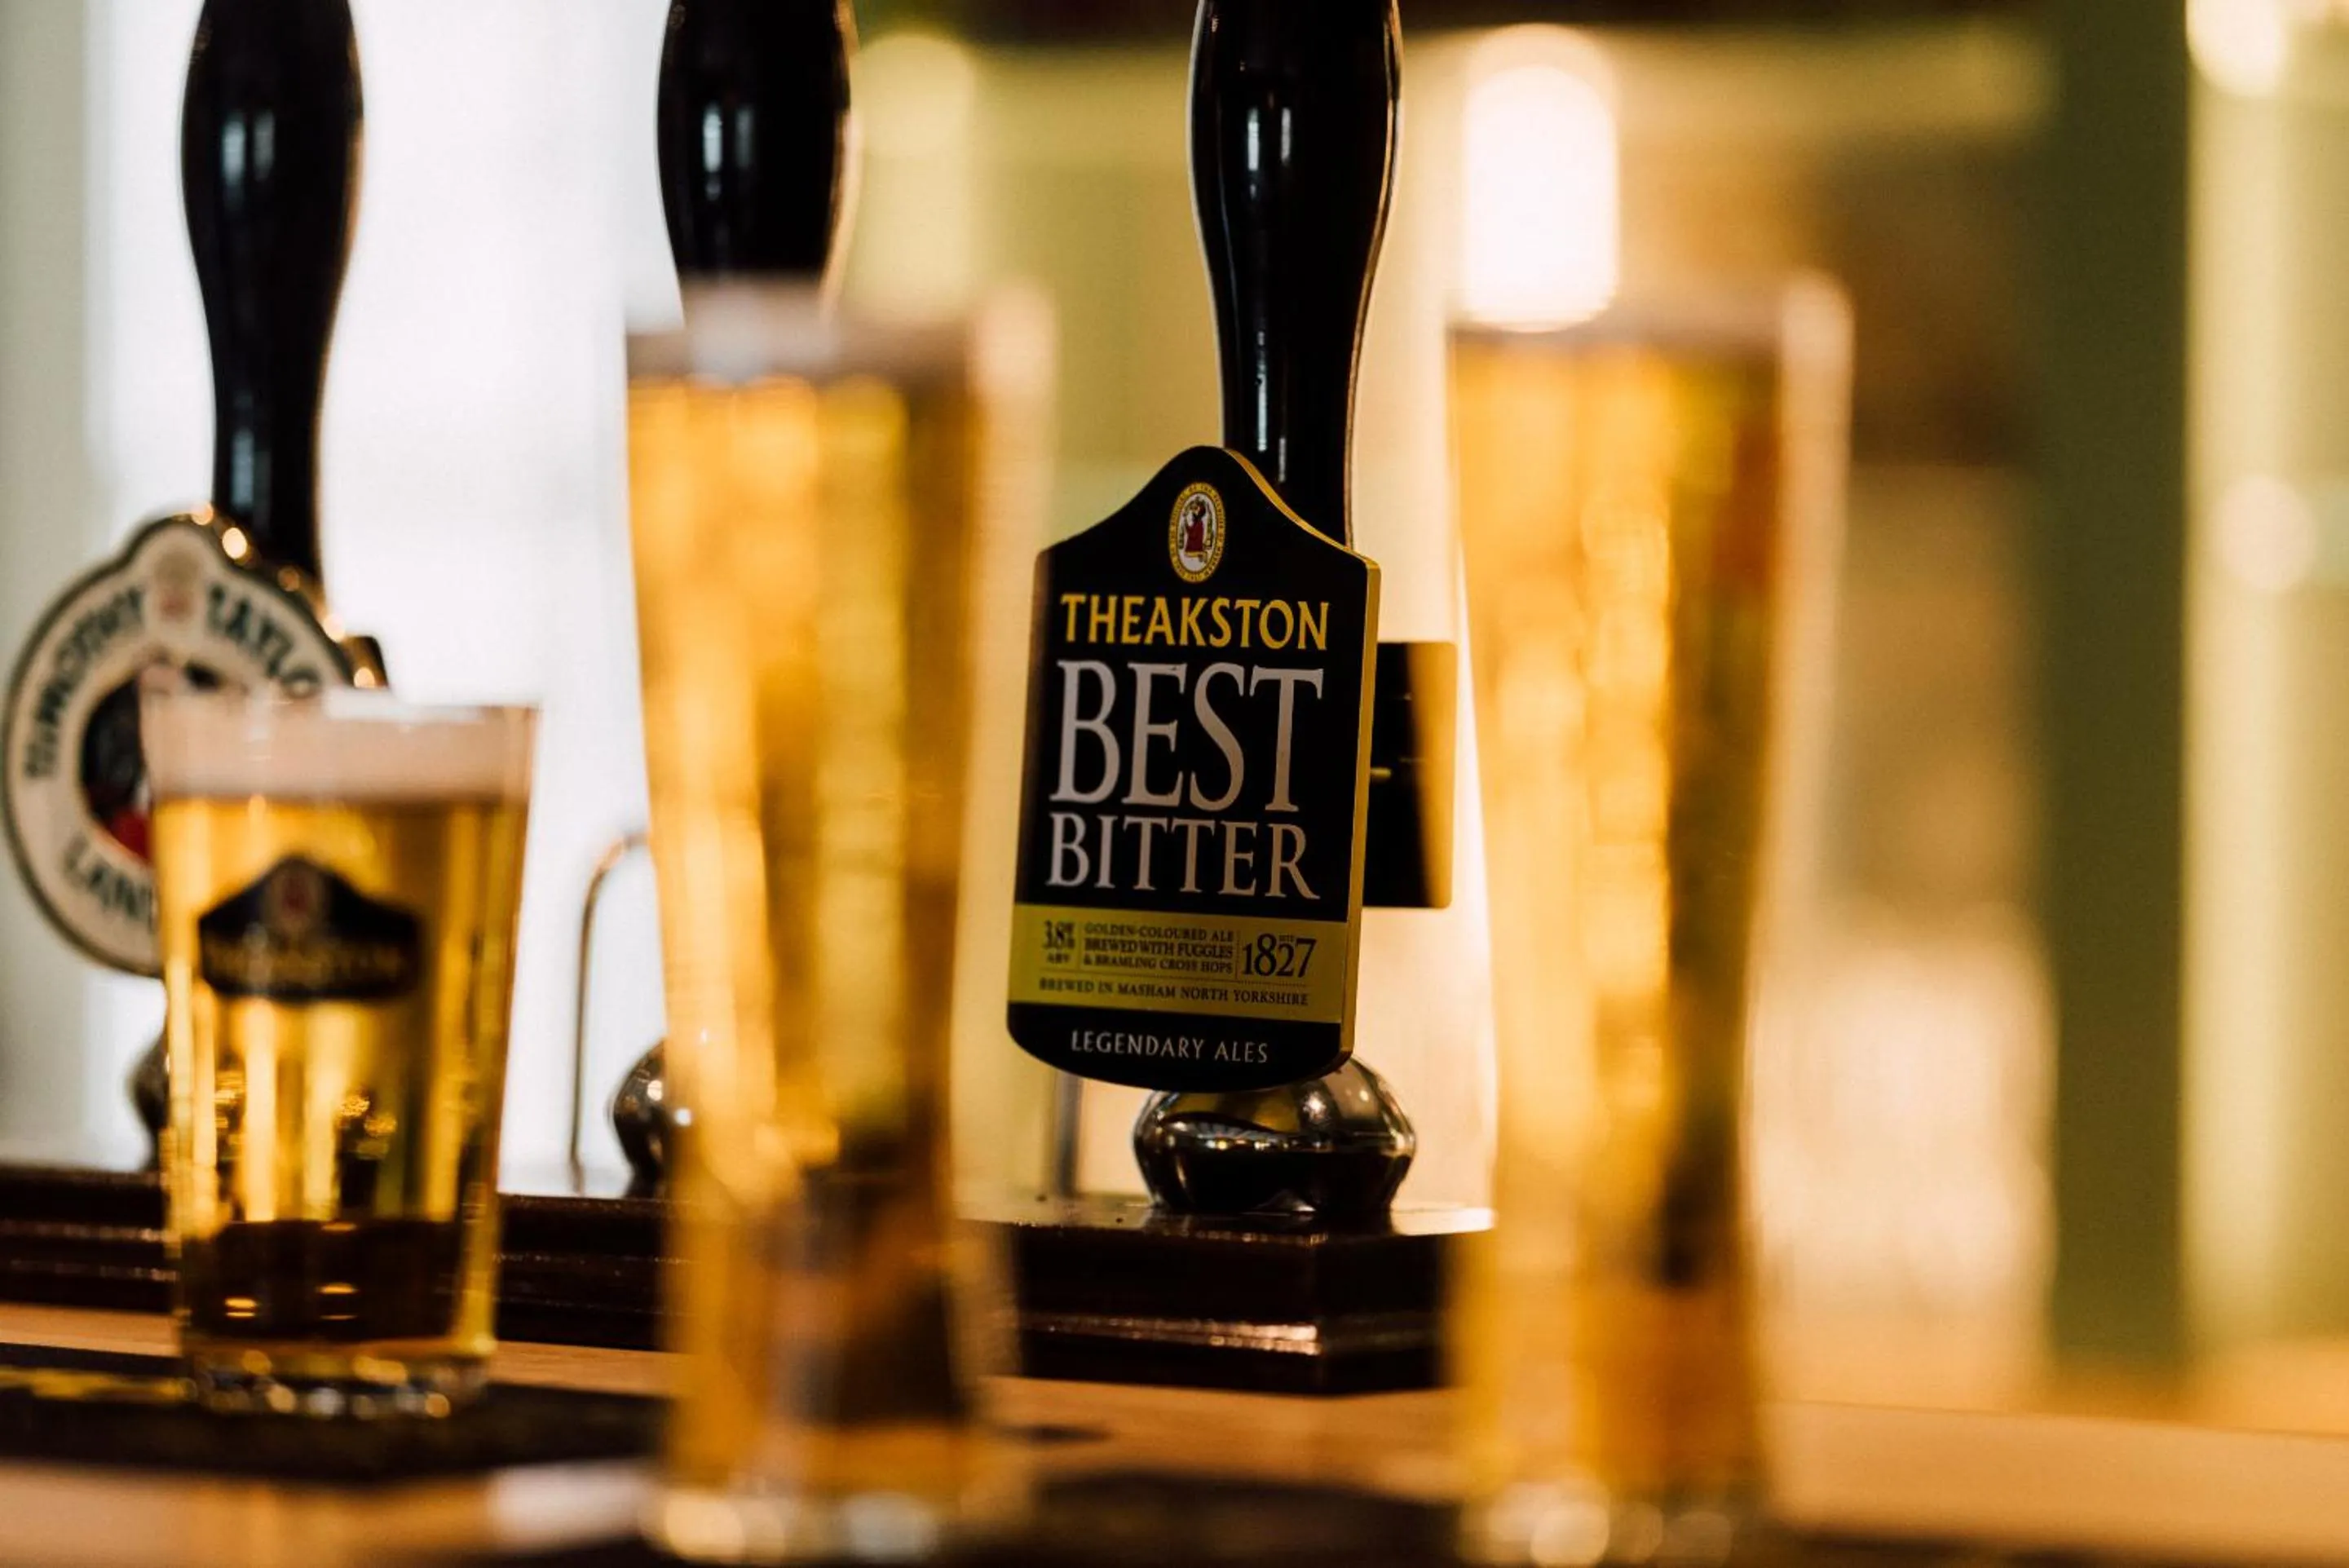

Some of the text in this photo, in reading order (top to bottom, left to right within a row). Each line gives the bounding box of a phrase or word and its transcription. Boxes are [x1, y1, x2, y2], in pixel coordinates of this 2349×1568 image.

[205, 582, 323, 695] TAYLO
[1061, 593, 1329, 651] THEAKSTON
[1049, 660, 1323, 812] BEST
[1044, 812, 1321, 899] BITTER
[1084, 922, 1234, 942] GOLDEN-COLOURED ALE
[1084, 937, 1234, 959] BREWED WITH FUGGLES
[1095, 954, 1156, 970] BRAMLING
[1159, 958, 1198, 972] CROSS
[1201, 960, 1233, 974] HOPS
[1242, 934, 1318, 978] 1827
[1040, 977, 1309, 1006] BREWED IN MASHAM NORTH YORKSHIRE
[1071, 1029, 1269, 1063] LEGENDARY ALES
